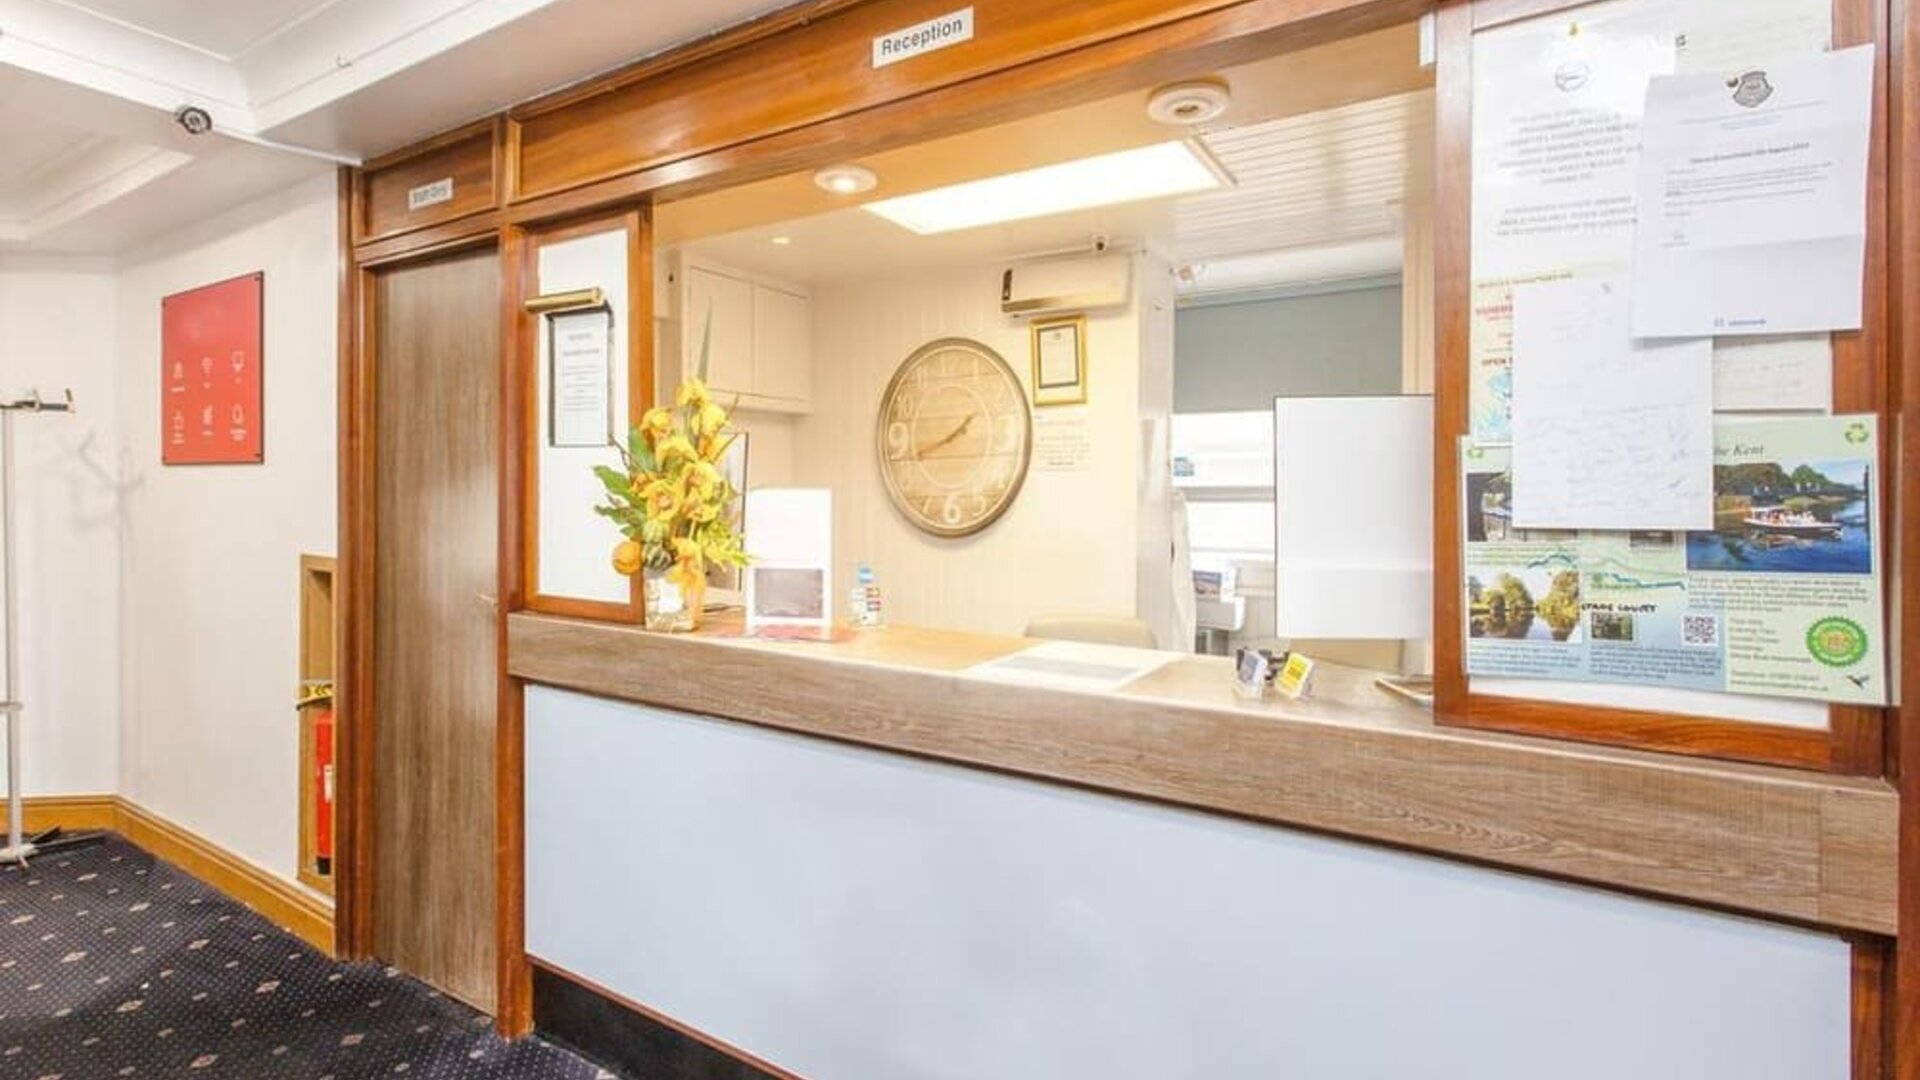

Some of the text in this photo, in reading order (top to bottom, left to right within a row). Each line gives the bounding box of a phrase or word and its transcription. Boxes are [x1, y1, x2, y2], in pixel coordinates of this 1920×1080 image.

[882, 19, 962, 56] Reception
[888, 421, 909, 461] 9
[1733, 443, 1764, 457] Kent
[943, 494, 961, 524] 6
